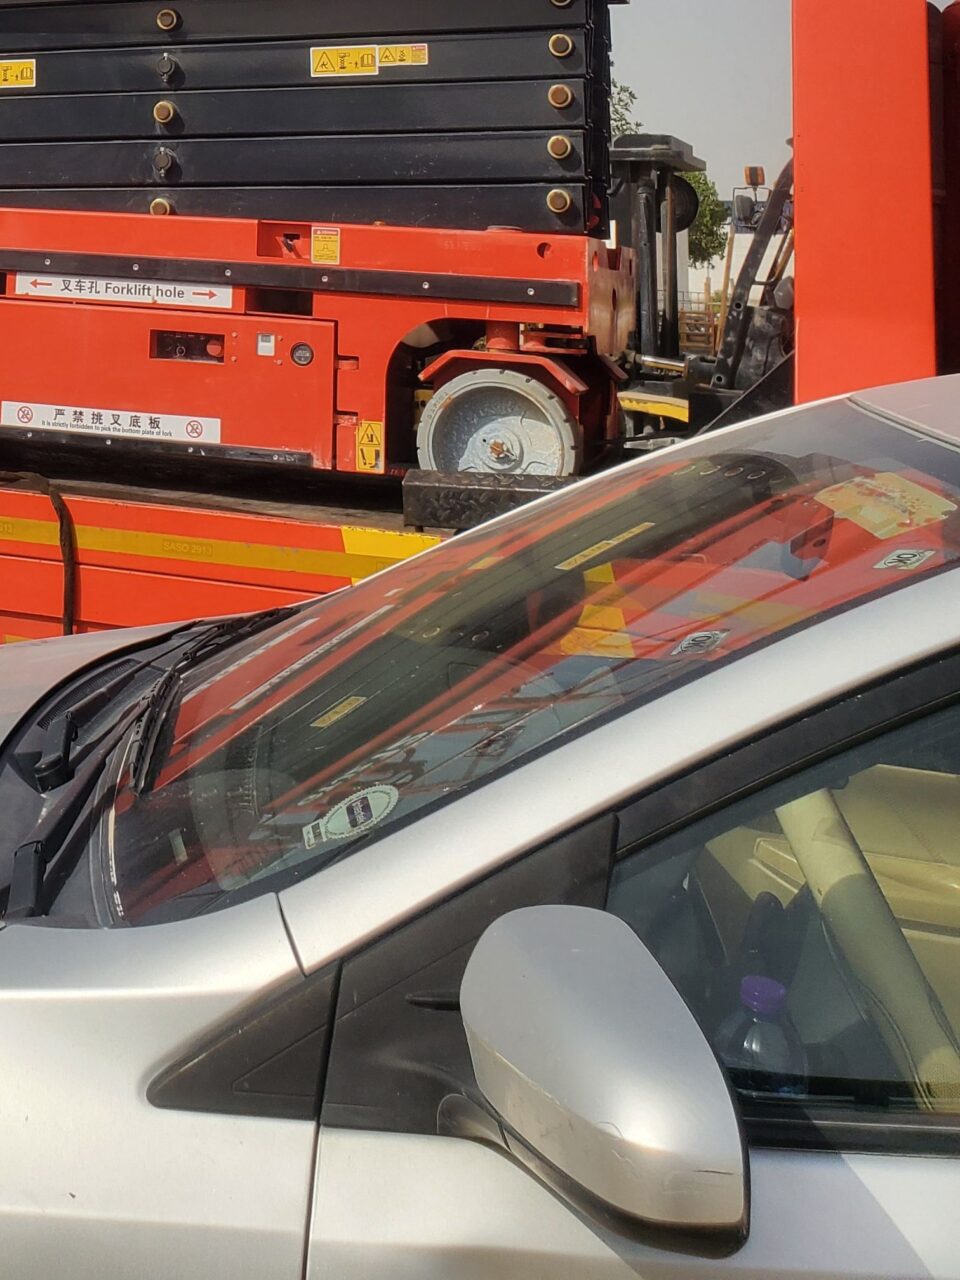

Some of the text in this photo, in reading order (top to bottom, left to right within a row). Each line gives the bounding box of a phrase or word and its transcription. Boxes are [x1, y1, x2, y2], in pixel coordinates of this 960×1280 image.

[60, 278, 185, 299] 叉车孔 Forklift hole
[54, 408, 161, 430] 严禁挑叉底板
[162, 540, 190, 553] SASO
